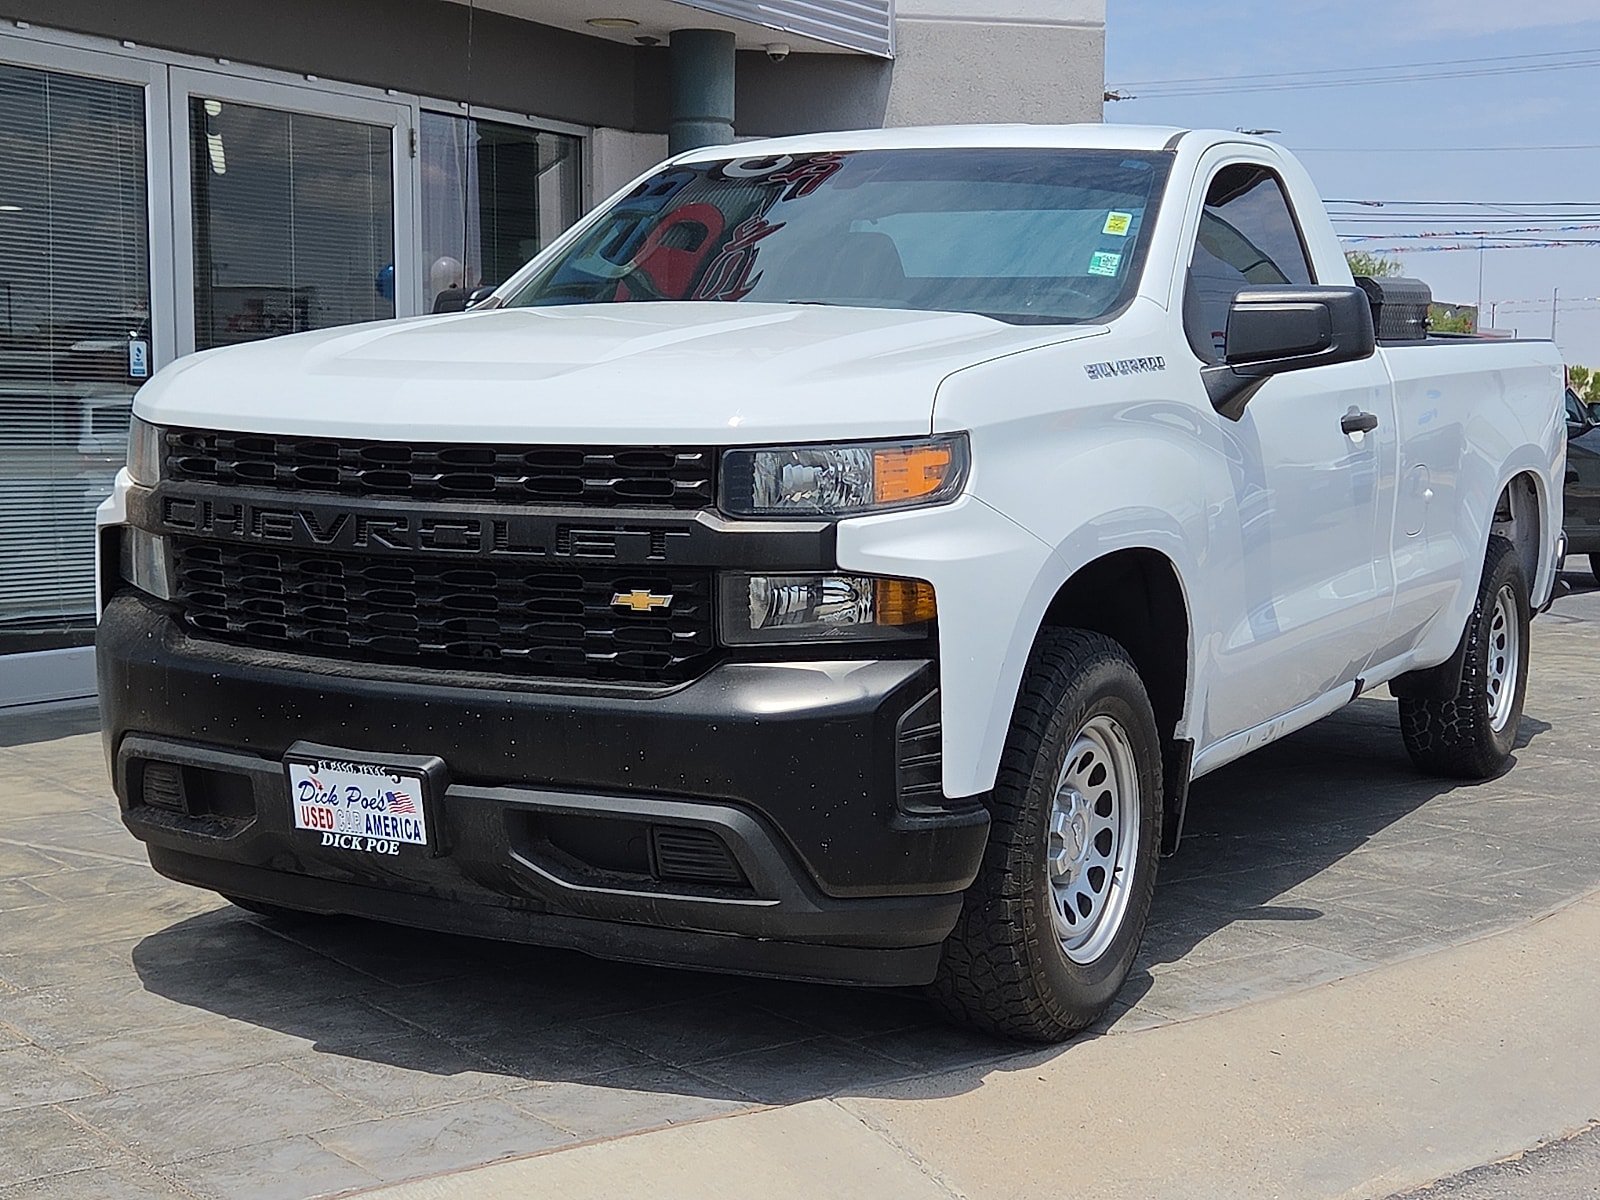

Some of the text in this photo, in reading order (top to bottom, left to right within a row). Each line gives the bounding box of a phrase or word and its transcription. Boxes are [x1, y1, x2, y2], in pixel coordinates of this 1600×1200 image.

[1084, 356, 1166, 380] SILVERADO
[162, 496, 691, 561] CHEVROLET
[298, 781, 387, 812] Dick Poe's
[301, 805, 422, 841] USED CAR AMERICA
[321, 832, 400, 856] DICK POE
